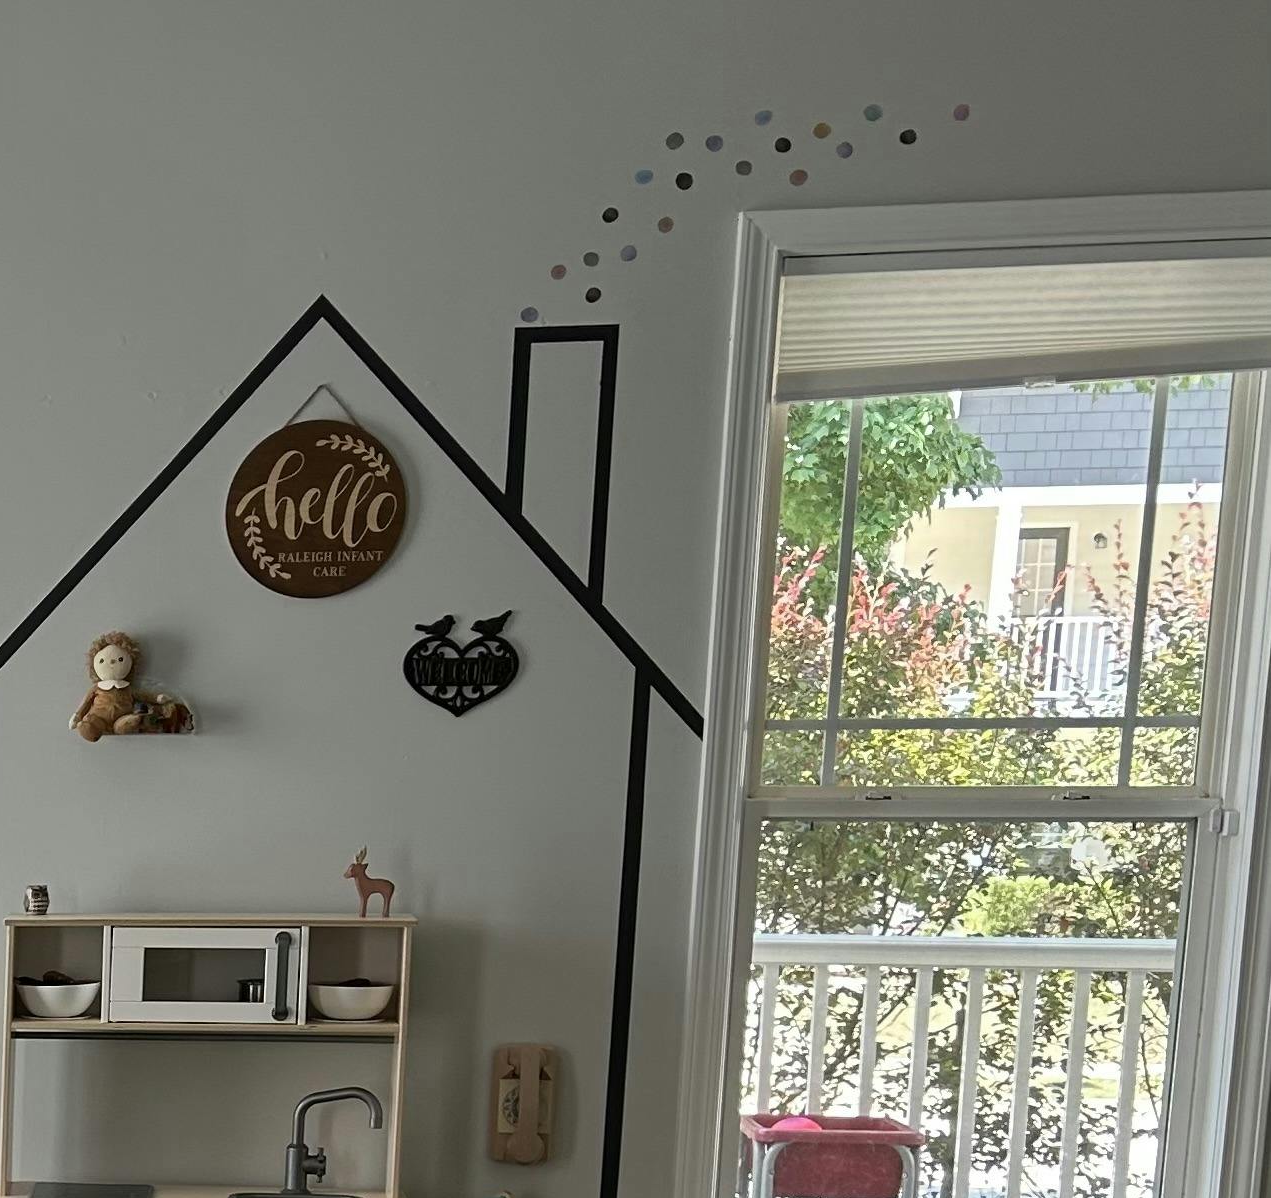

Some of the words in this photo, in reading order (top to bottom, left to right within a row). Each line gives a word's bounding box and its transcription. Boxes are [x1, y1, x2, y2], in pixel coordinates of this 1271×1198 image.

[235, 449, 398, 548] hello
[277, 551, 332, 564] RALEIGH
[336, 550, 385, 563] INFANT
[312, 565, 347, 578] CARE
